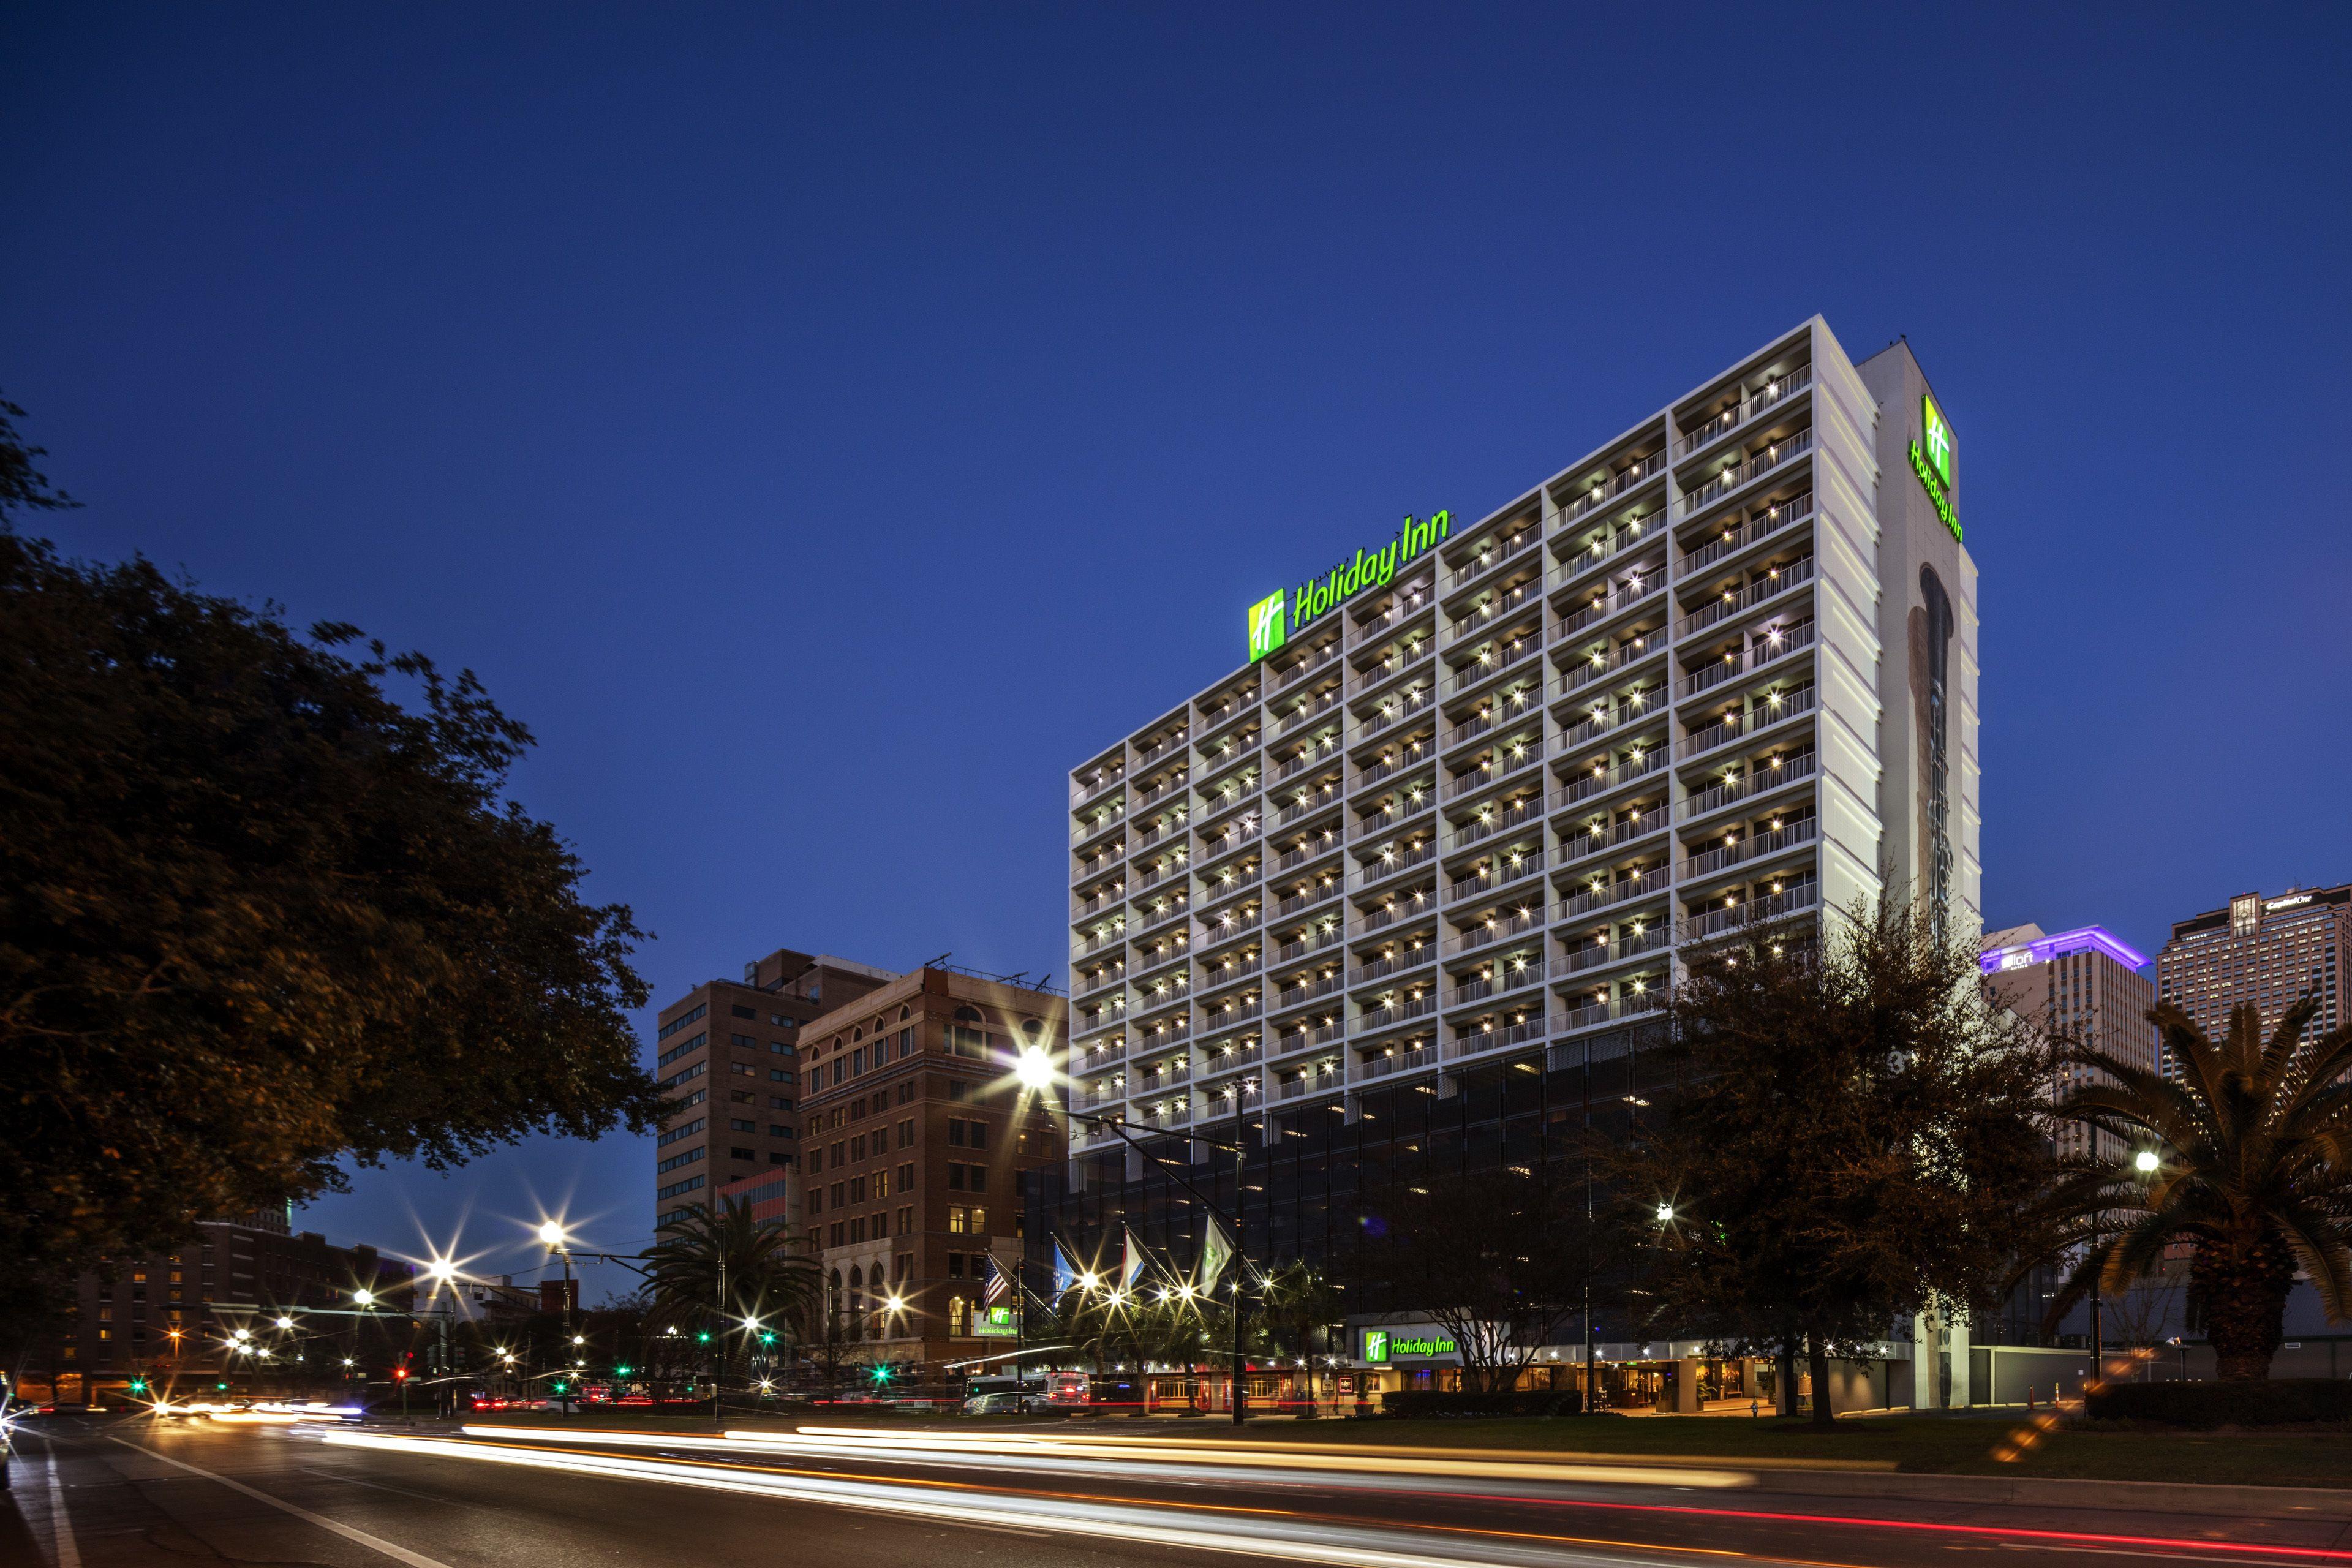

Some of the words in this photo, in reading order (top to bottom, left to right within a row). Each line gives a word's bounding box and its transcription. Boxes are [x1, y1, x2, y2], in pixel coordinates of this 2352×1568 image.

[1910, 439, 1948, 521] Holiday
[1948, 503, 1963, 543] Inn
[1293, 540, 1398, 628] Holiday
[1402, 510, 1449, 562] Inn
[2002, 951, 2034, 969] loft
[979, 1326, 1008, 1336] Holiday
[1392, 1338, 1434, 1357] Holiday
[1434, 1336, 1454, 1352] Inn
